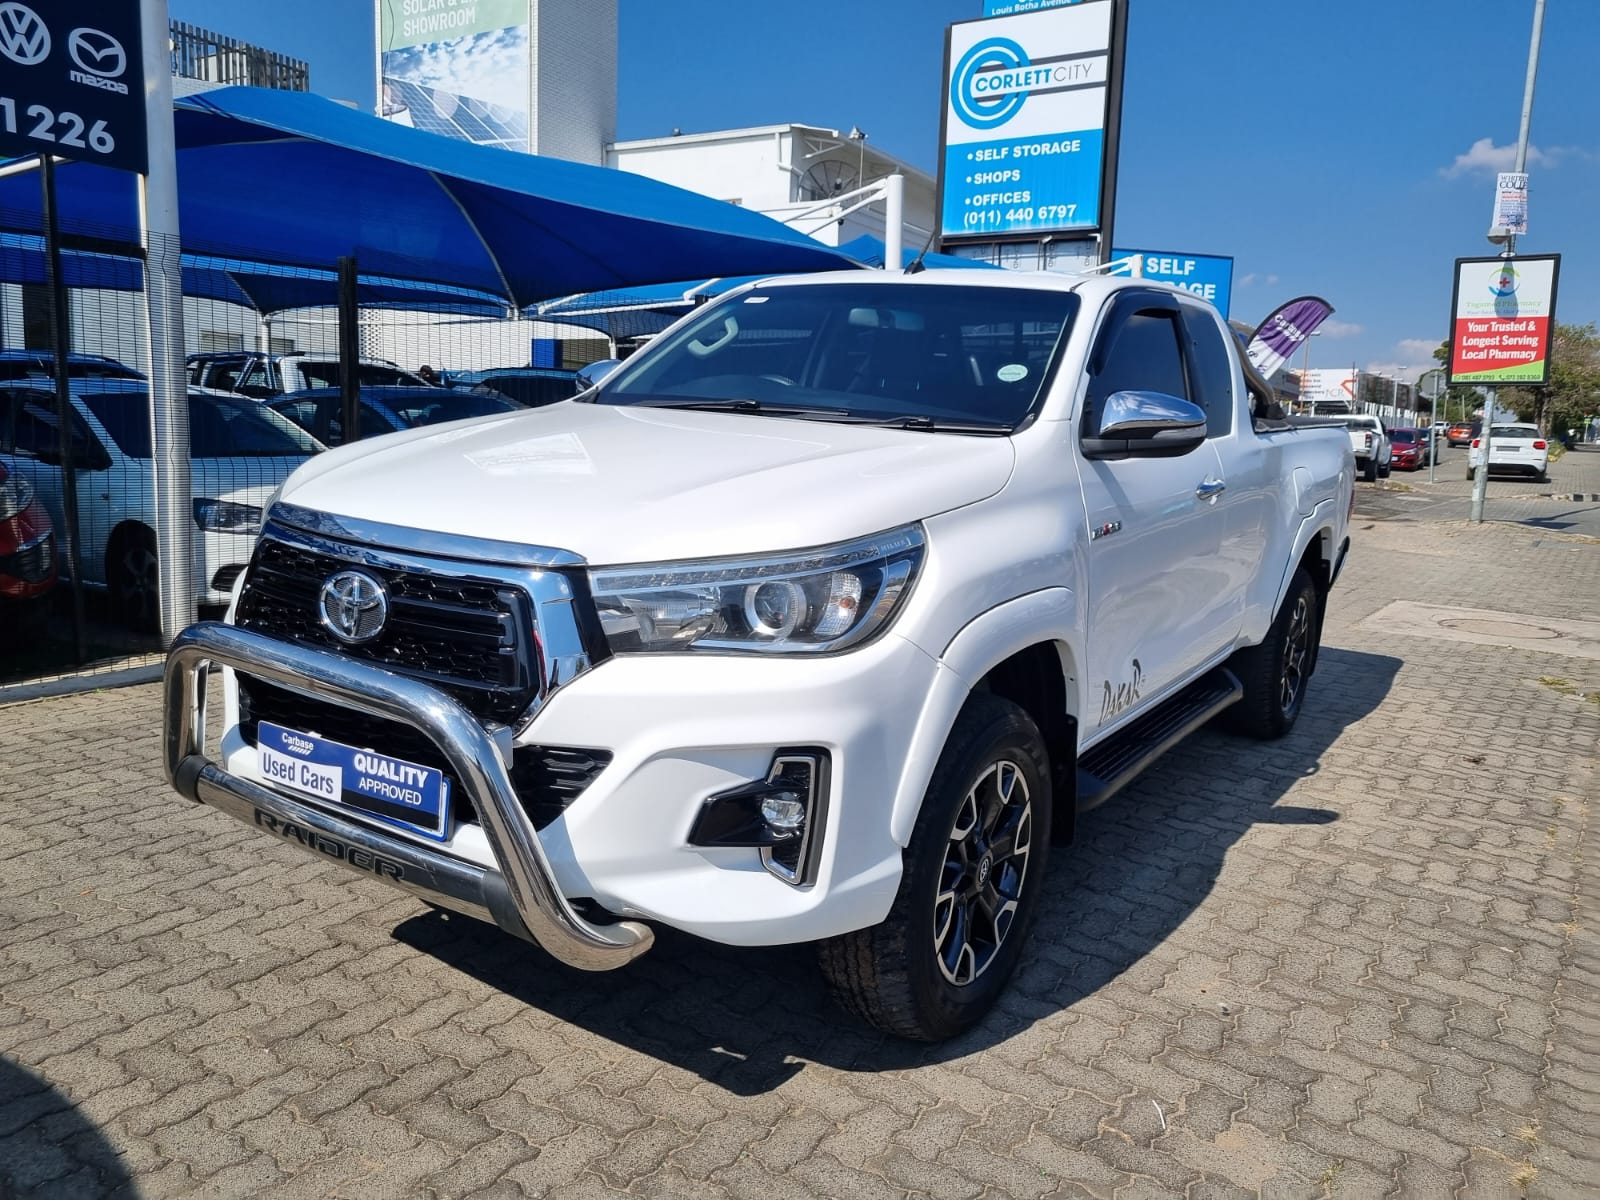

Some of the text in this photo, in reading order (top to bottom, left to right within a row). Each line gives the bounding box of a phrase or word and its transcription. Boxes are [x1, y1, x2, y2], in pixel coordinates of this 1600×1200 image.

[991, 6, 1013, 16] Louis
[1014, 2, 1039, 12] Botha
[403, 6, 476, 37] SHOWROOM
[975, 140, 1081, 162] SELF STORAGE
[974, 169, 1021, 185] SHOPS
[973, 191, 1031, 206] OFFICES
[964, 204, 1077, 227] (011) 440 6797
[1146, 257, 1195, 276] SELF
[1467, 320, 1536, 332] Your Trusted &
[1462, 335, 1539, 348] Longest Serving
[1462, 349, 1537, 361] Local Pharmacy
[281, 732, 314, 750] Carbase
[263, 752, 334, 795] Used Cars
[354, 753, 429, 789] QUALITY
[359, 777, 422, 806] APPROVED
[254, 808, 405, 882] RAIDER
